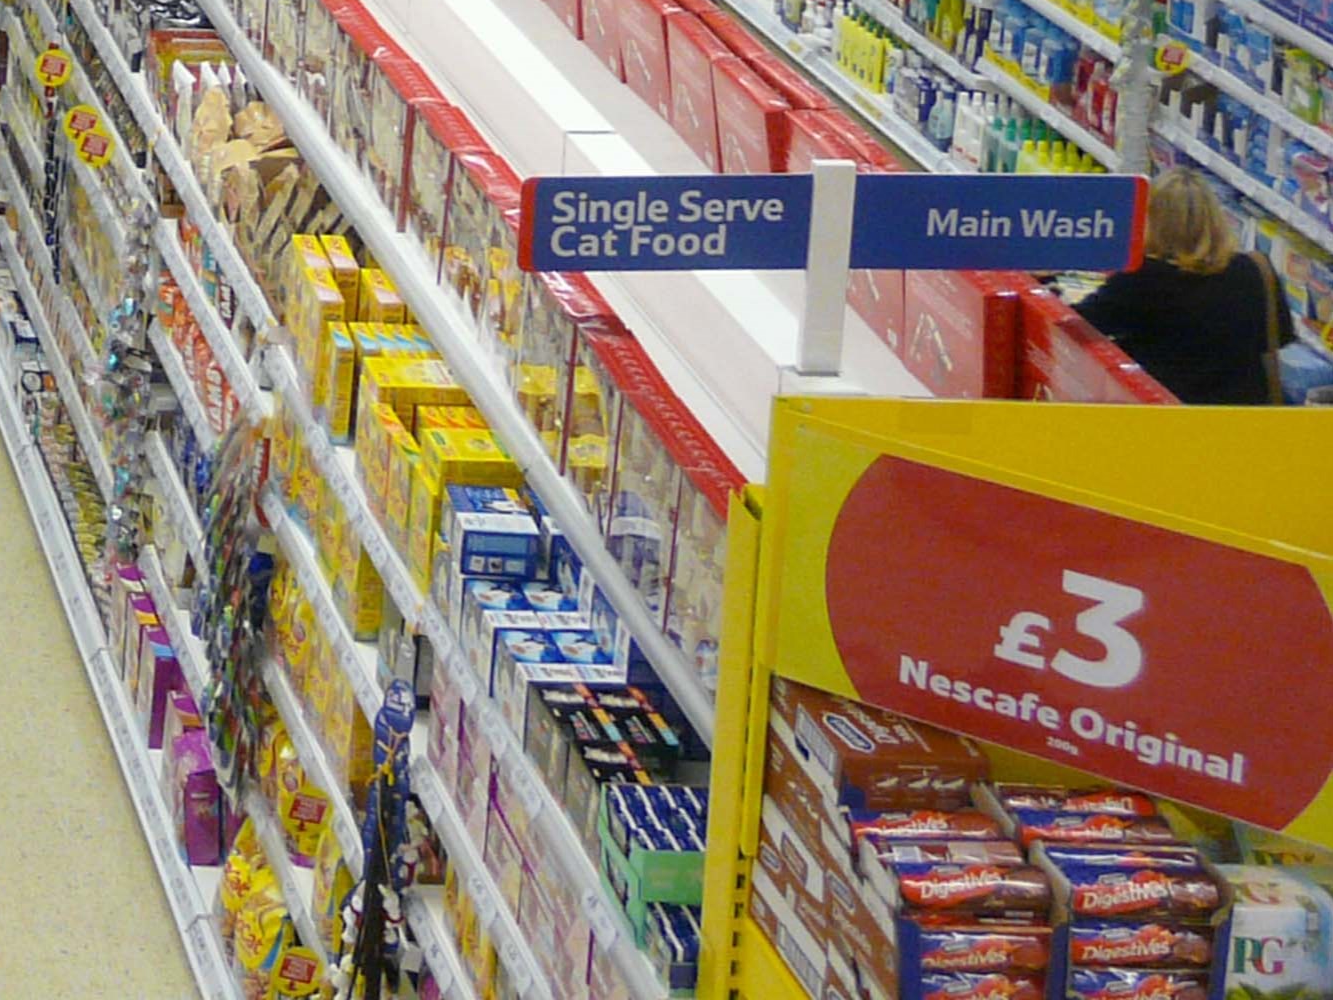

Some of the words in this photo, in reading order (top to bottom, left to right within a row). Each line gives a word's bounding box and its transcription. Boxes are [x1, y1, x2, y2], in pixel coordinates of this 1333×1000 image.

[551, 190, 670, 231] Single
[679, 191, 784, 222] Serve
[927, 208, 1011, 238] Main
[1020, 208, 1115, 239] Wash
[550, 226, 618, 258] Cat
[631, 225, 727, 257] Food
[994, 569, 1147, 688] £3
[899, 655, 1061, 732] Nescafe
[1071, 706, 1244, 786] Original
[1046, 736, 1079, 756] 200g
[920, 869, 1002, 900] Digestives
[1082, 881, 1169, 910] Digestives
[1082, 941, 1170, 962] Digestives
[1232, 937, 1285, 975] PG
